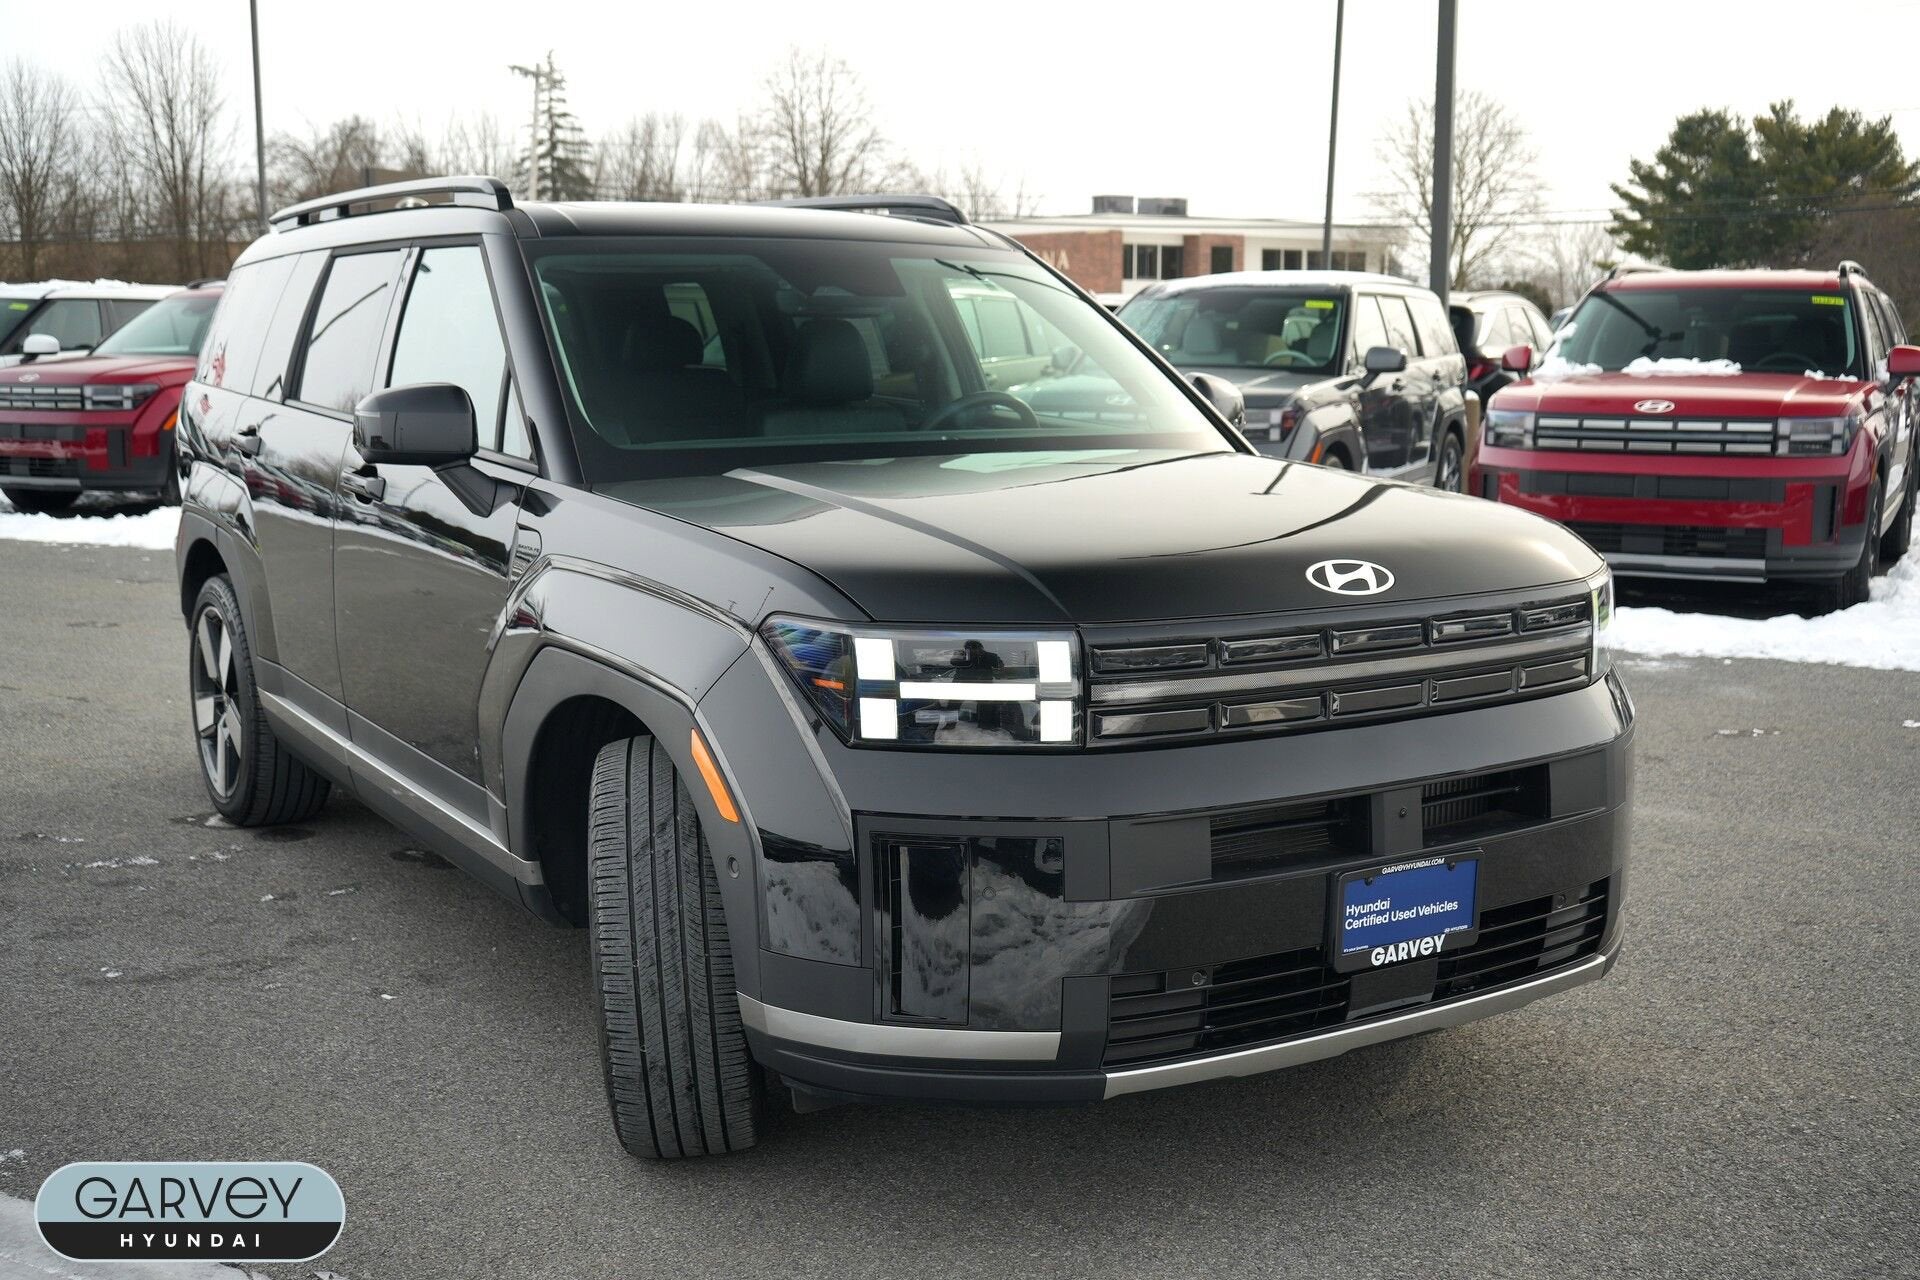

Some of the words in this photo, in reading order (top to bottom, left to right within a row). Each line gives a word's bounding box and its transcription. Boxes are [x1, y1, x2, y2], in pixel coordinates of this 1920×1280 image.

[1345, 912, 1389, 930] Certified
[1391, 906, 1417, 922] Used
[1418, 900, 1458, 917] Vehicles
[1346, 897, 1391, 917] Hyundai
